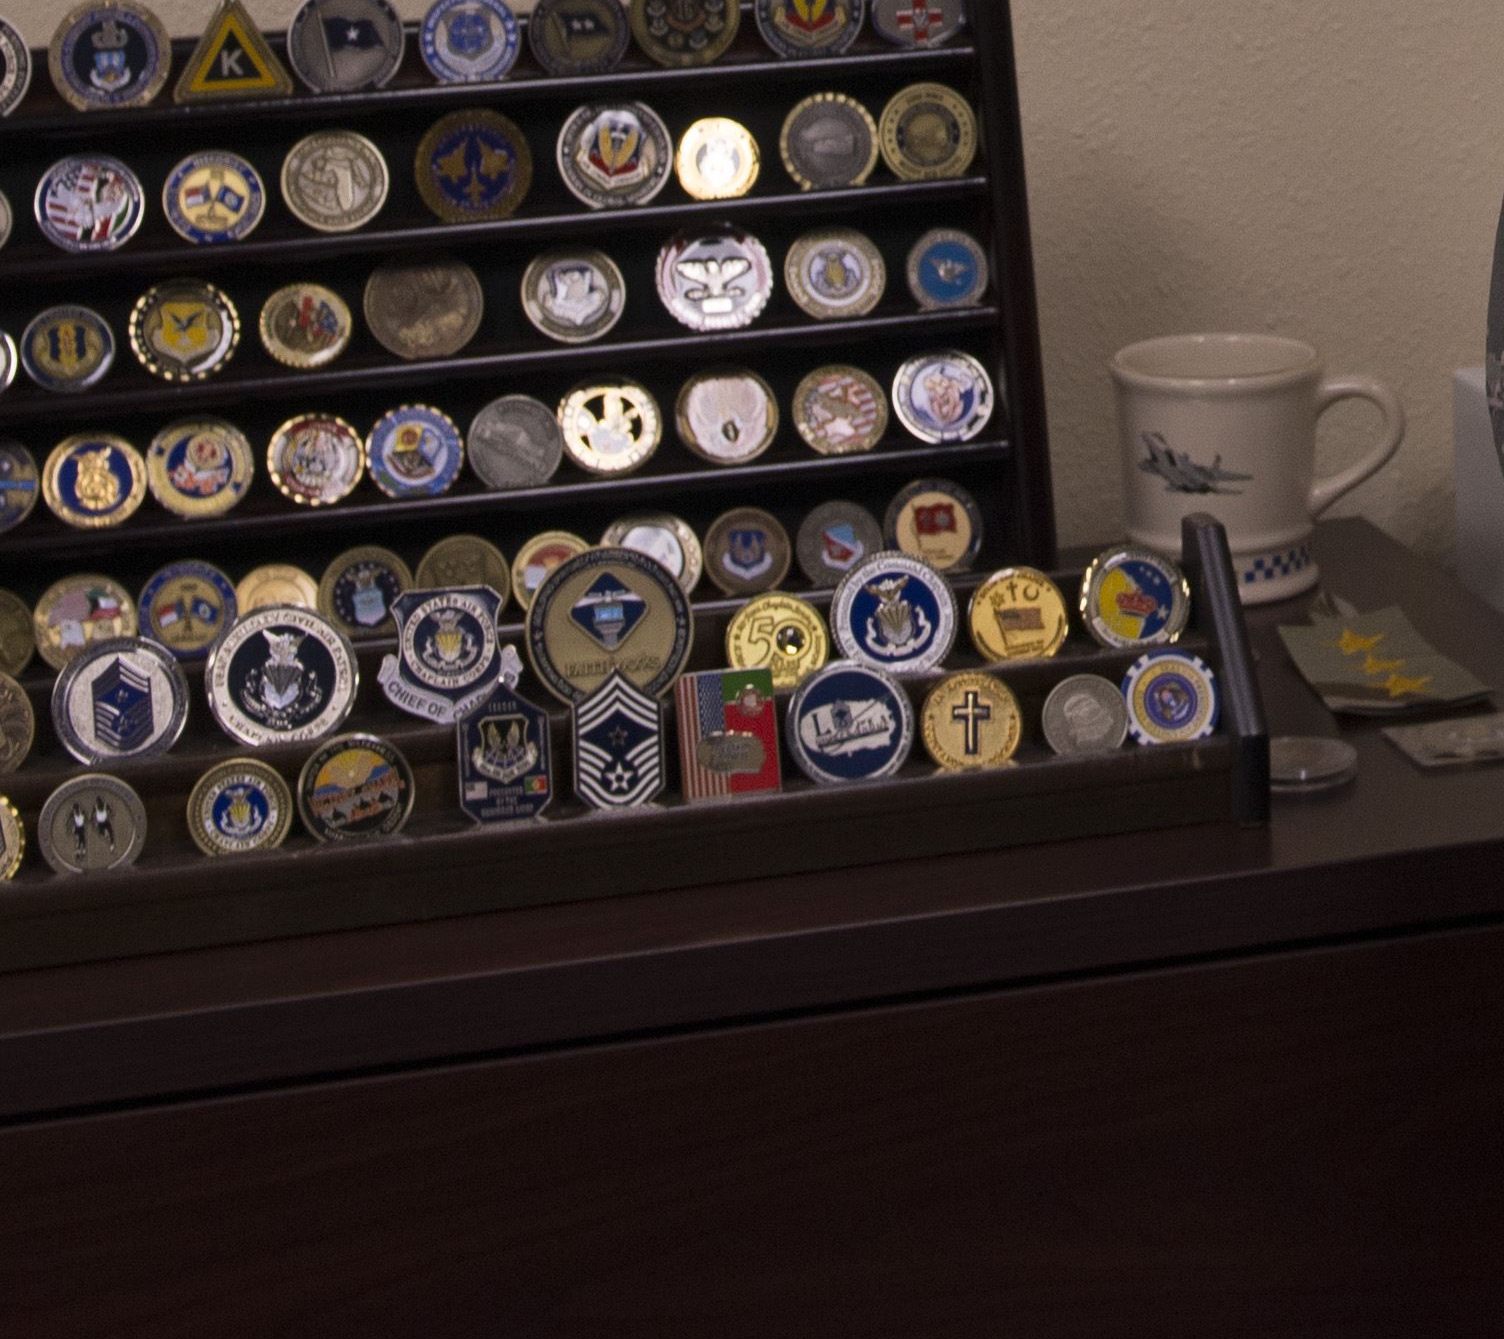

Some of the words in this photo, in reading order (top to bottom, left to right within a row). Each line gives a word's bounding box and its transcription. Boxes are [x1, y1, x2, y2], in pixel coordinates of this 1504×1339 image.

[221, 49, 243, 77] K
[745, 615, 812, 665] 50
[387, 679, 428, 713] CHIEF
[427, 698, 447, 719] OF
